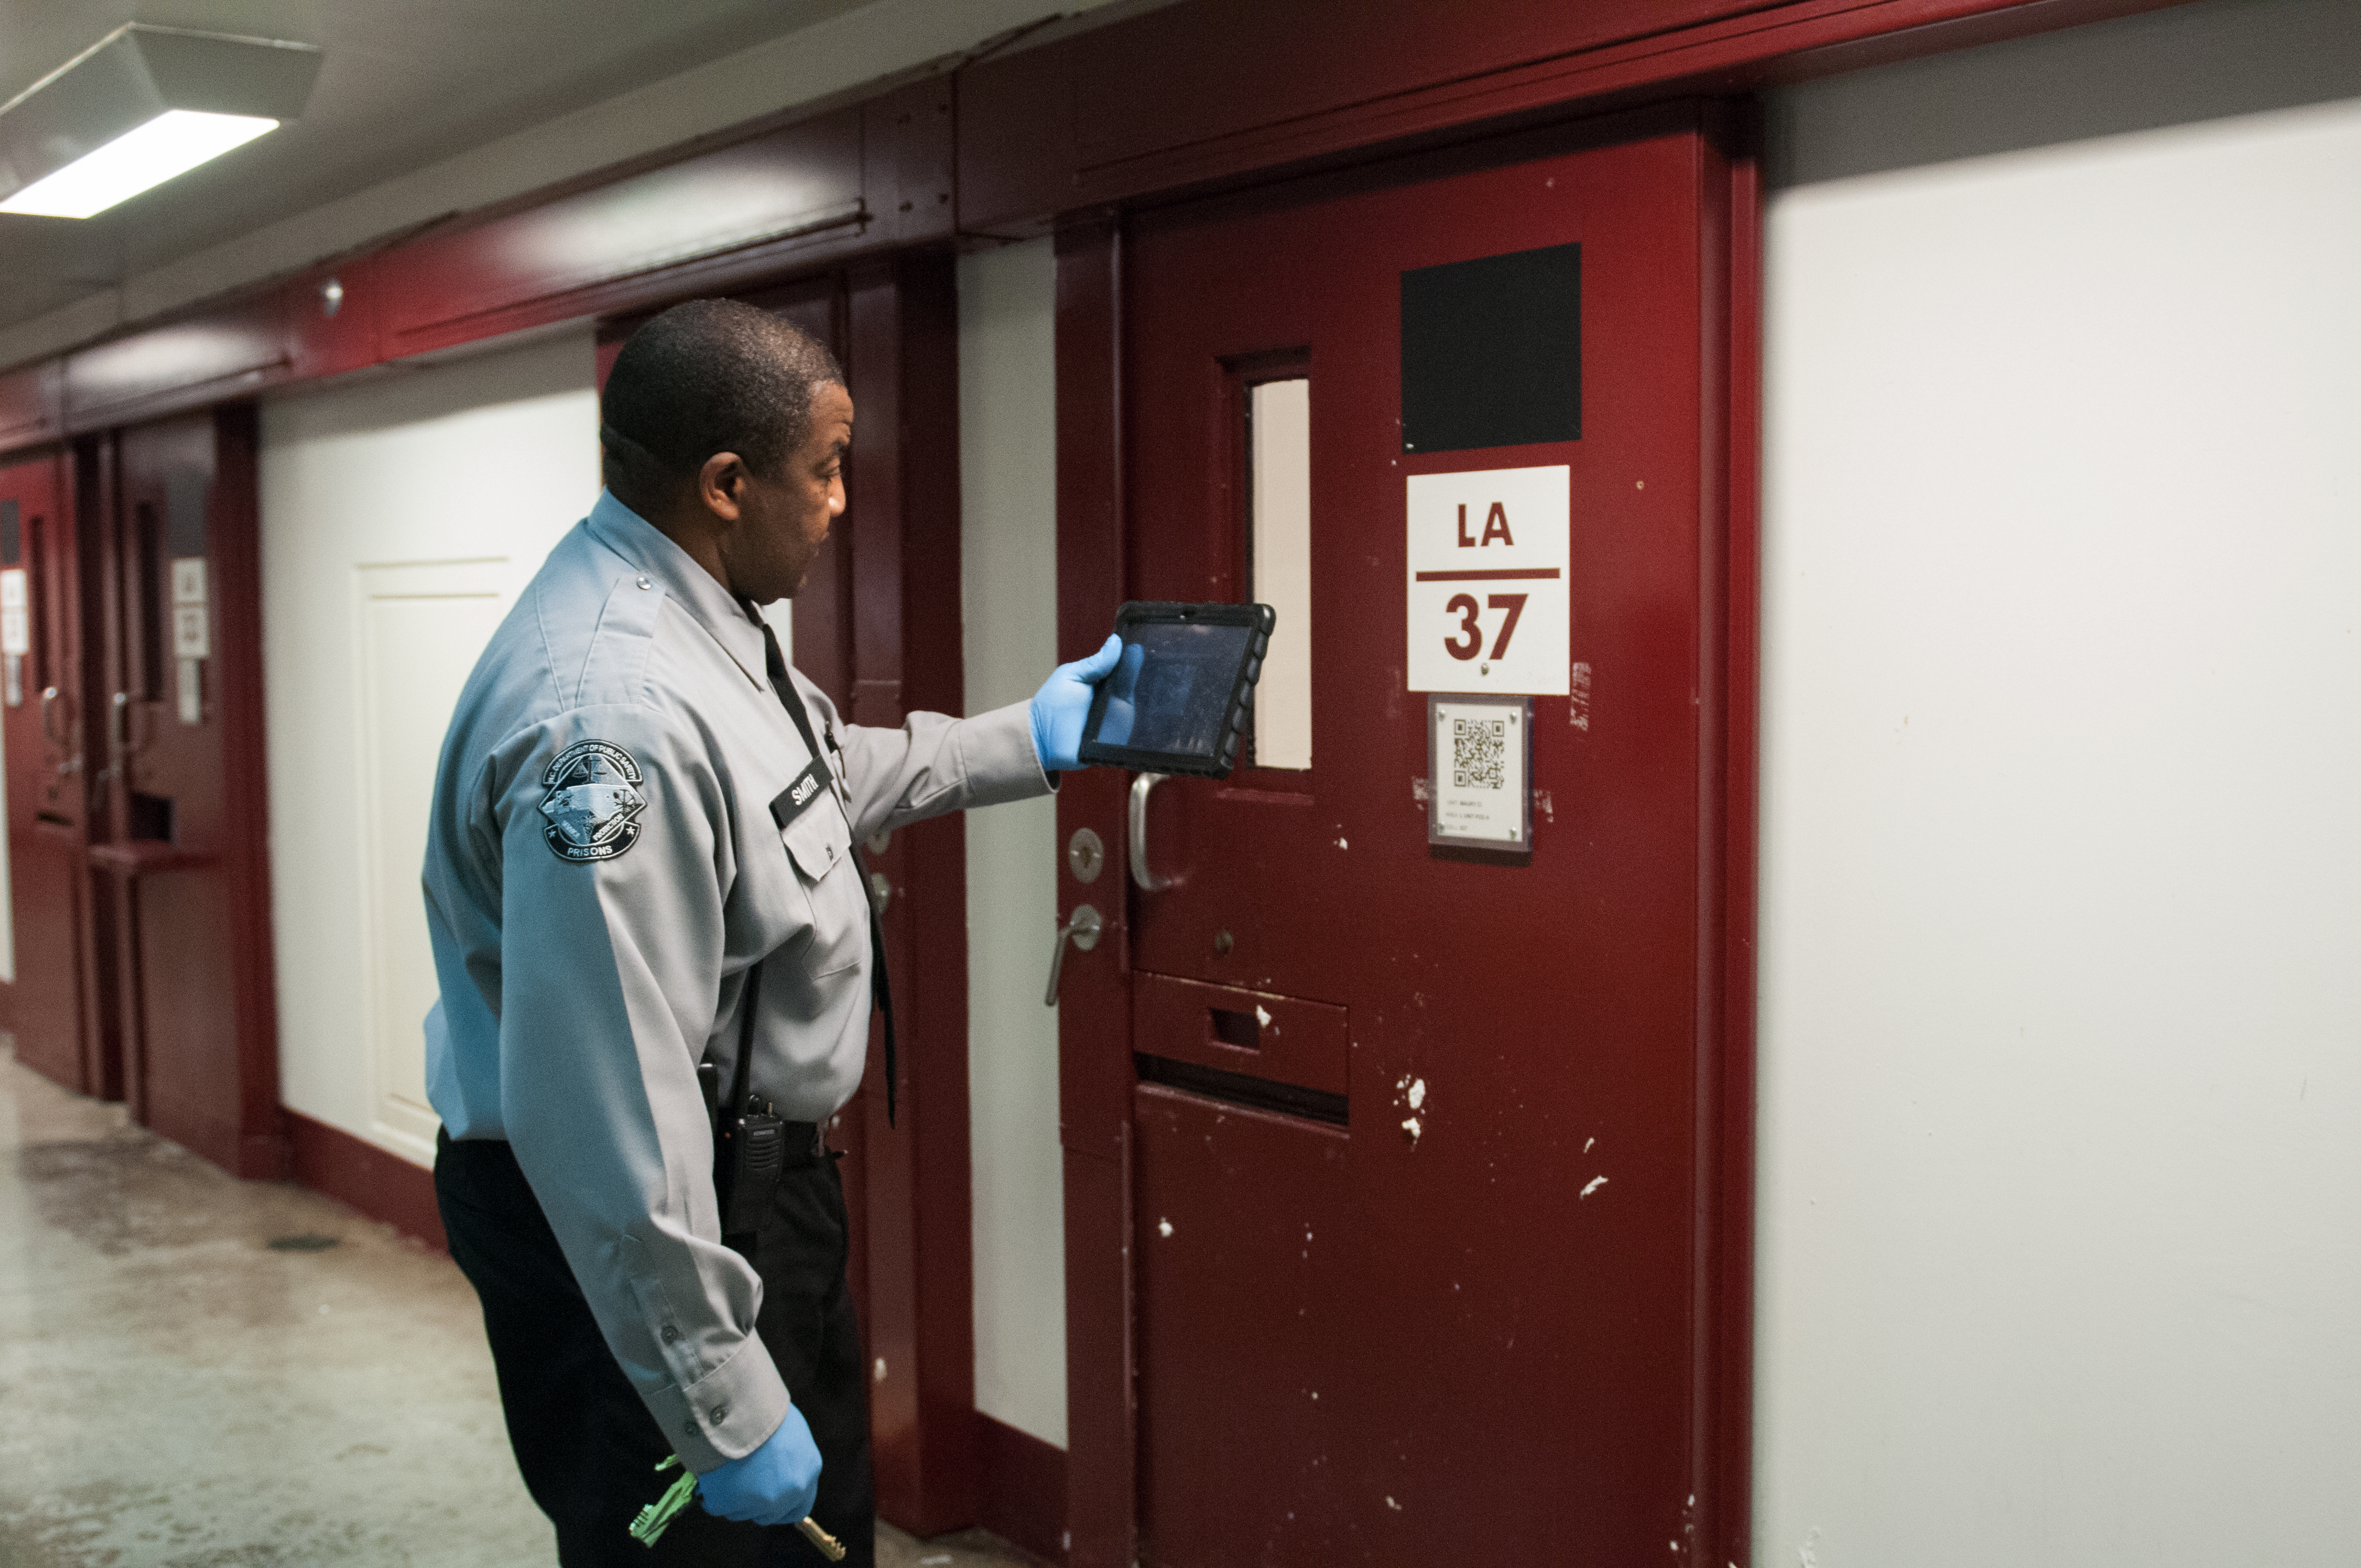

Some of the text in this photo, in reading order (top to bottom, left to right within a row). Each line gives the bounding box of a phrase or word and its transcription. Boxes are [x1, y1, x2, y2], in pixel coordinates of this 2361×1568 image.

[1458, 502, 1514, 547] LA
[1444, 593, 1529, 661] 37
[552, 745, 588, 771] DEPARTMENT
[599, 745, 622, 760] PUBLIC
[619, 757, 637, 780] SAFETY
[792, 774, 819, 805] SMITH
[592, 813, 624, 841] PROTECTION
[567, 845, 613, 857] PRISONS
